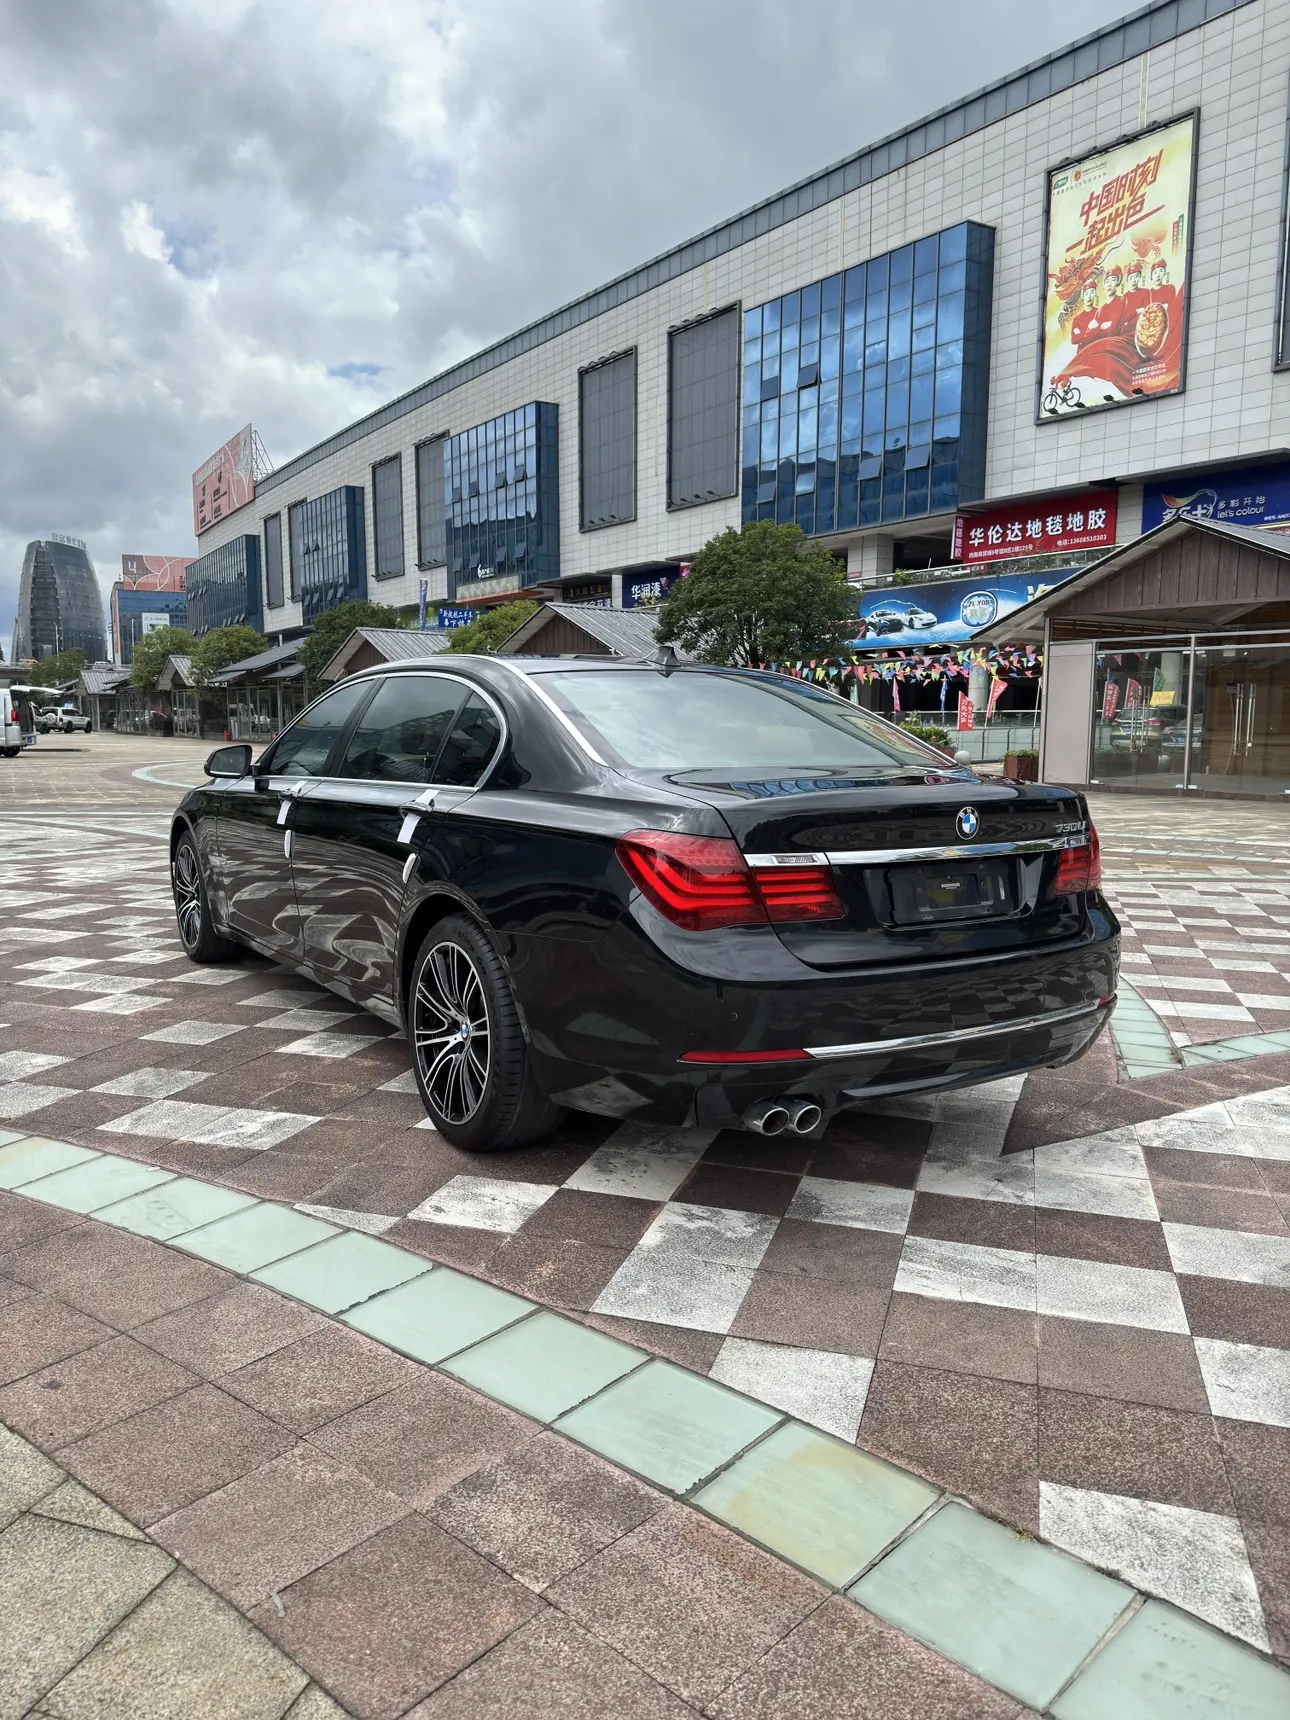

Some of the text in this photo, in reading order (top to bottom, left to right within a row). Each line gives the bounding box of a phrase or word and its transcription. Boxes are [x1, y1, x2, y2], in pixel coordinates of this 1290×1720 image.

[1079, 149, 1163, 227] 中国时刻
[1065, 192, 1165, 256] 一起出色
[1217, 509, 1234, 519] let's
[1235, 506, 1265, 517] colour
[1218, 495, 1266, 510] 多彩开始
[954, 518, 964, 557] 地毯地胶
[969, 508, 1107, 547] 华伦达地毯地胶
[631, 581, 662, 600] 华润漆
